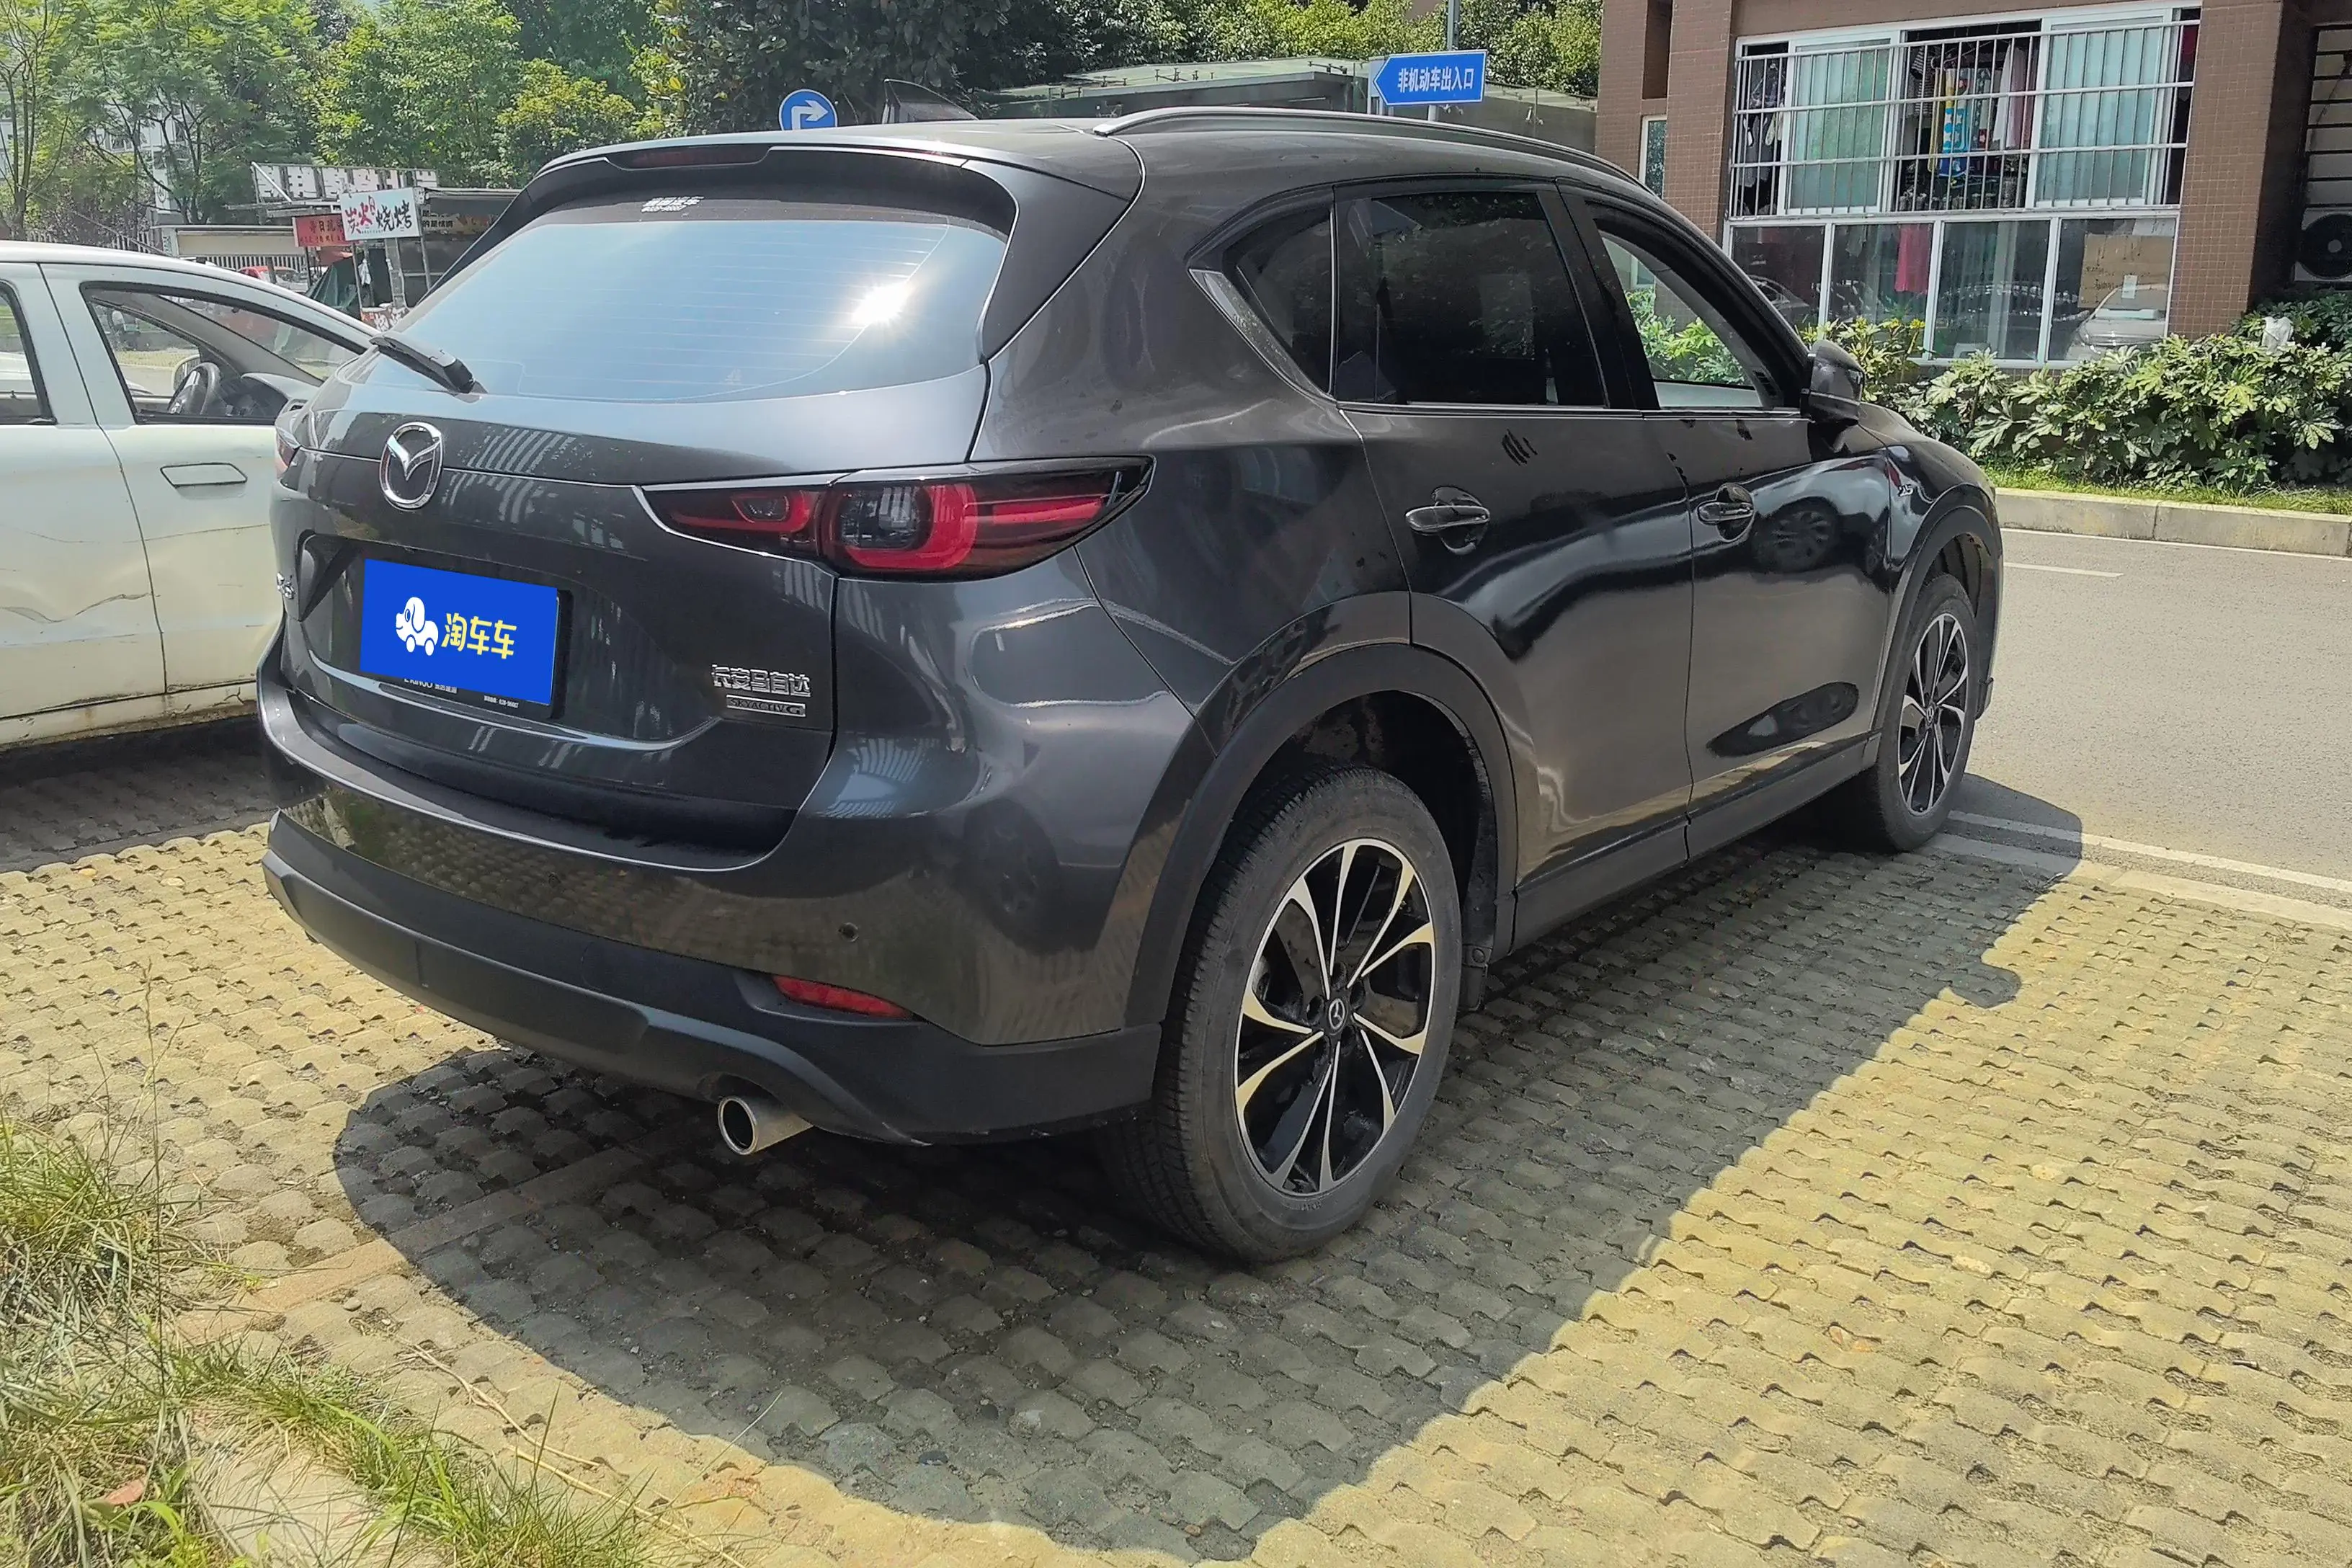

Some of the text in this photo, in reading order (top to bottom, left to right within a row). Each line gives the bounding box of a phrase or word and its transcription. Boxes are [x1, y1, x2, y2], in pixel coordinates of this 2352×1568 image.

[1397, 66, 1474, 93] 非机动车出入口
[345, 199, 412, 234] 炭火烧烤
[711, 664, 811, 697] 长安马自达
